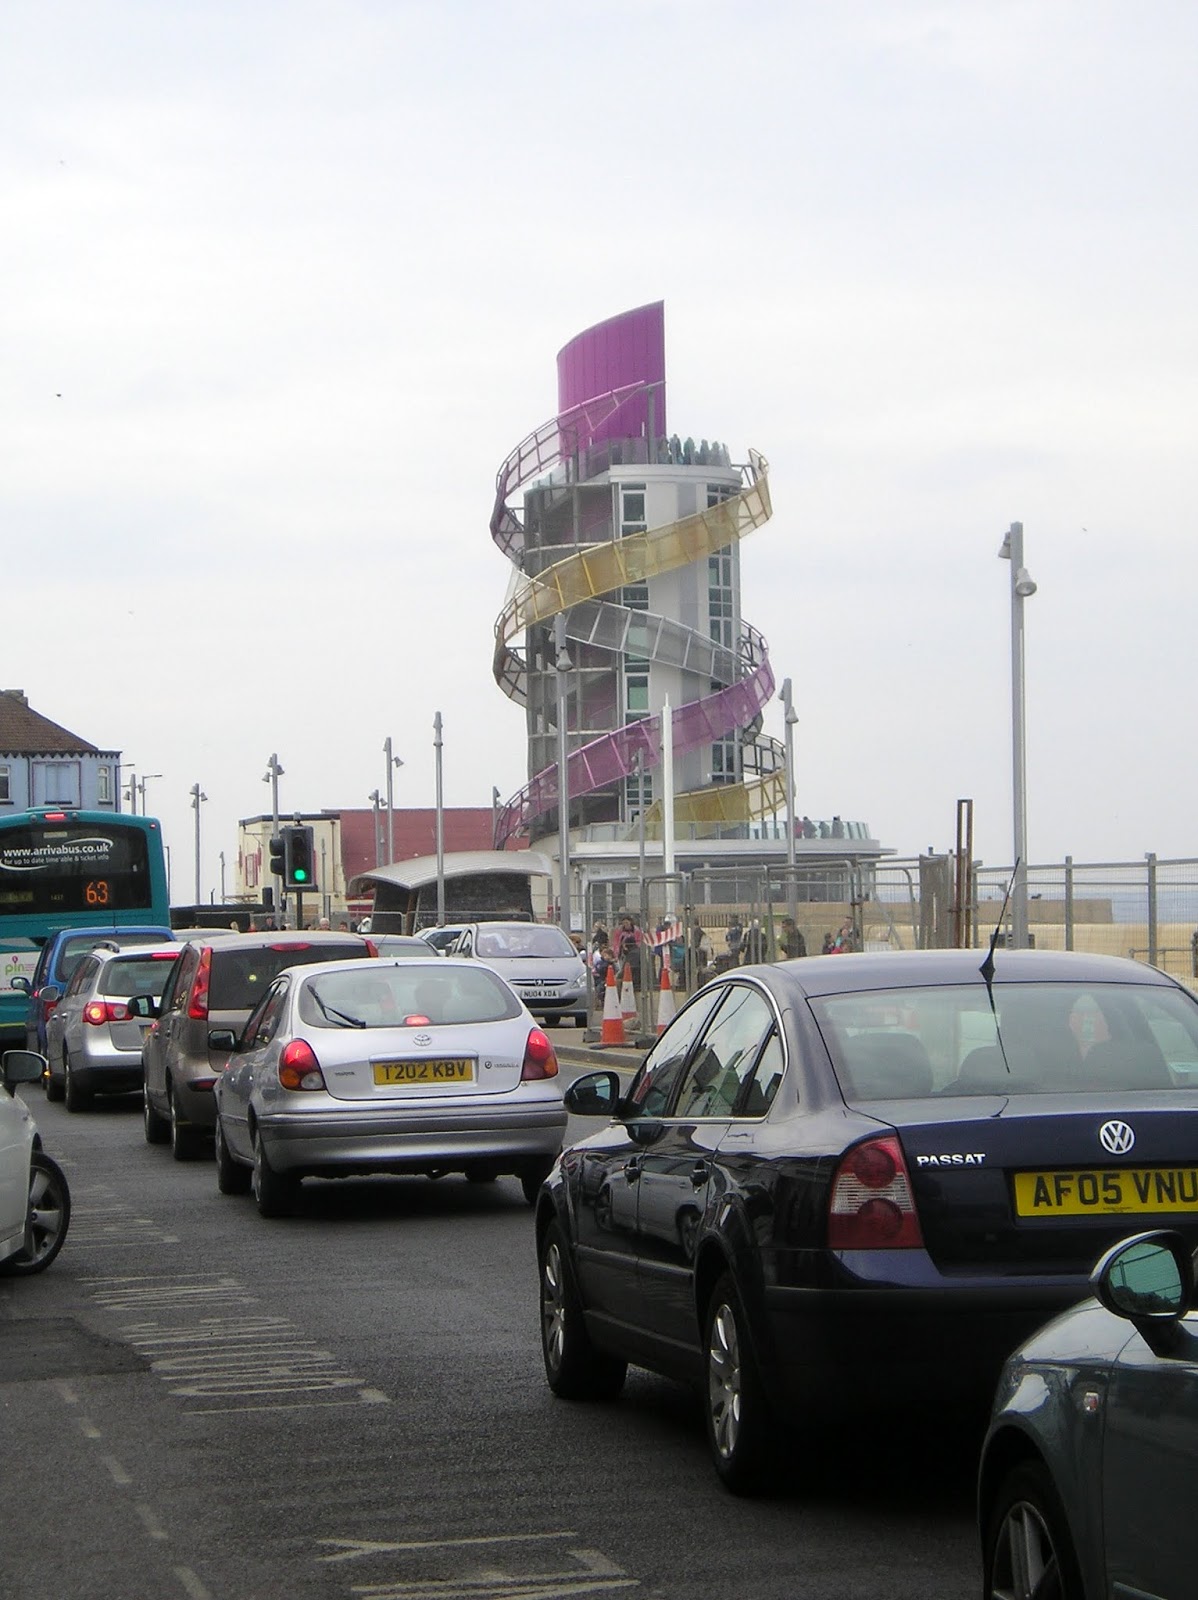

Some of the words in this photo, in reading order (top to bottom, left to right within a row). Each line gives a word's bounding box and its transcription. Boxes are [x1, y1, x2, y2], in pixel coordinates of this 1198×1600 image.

[3, 843, 109, 857] www.arrivabus.co.uk
[86, 880, 109, 904] 63
[381, 1063, 428, 1080] T202
[432, 1061, 467, 1079] KBV
[916, 1153, 986, 1167] PASSAT
[1033, 1174, 1123, 1208] AF05
[1132, 1169, 1198, 1204] VNU
